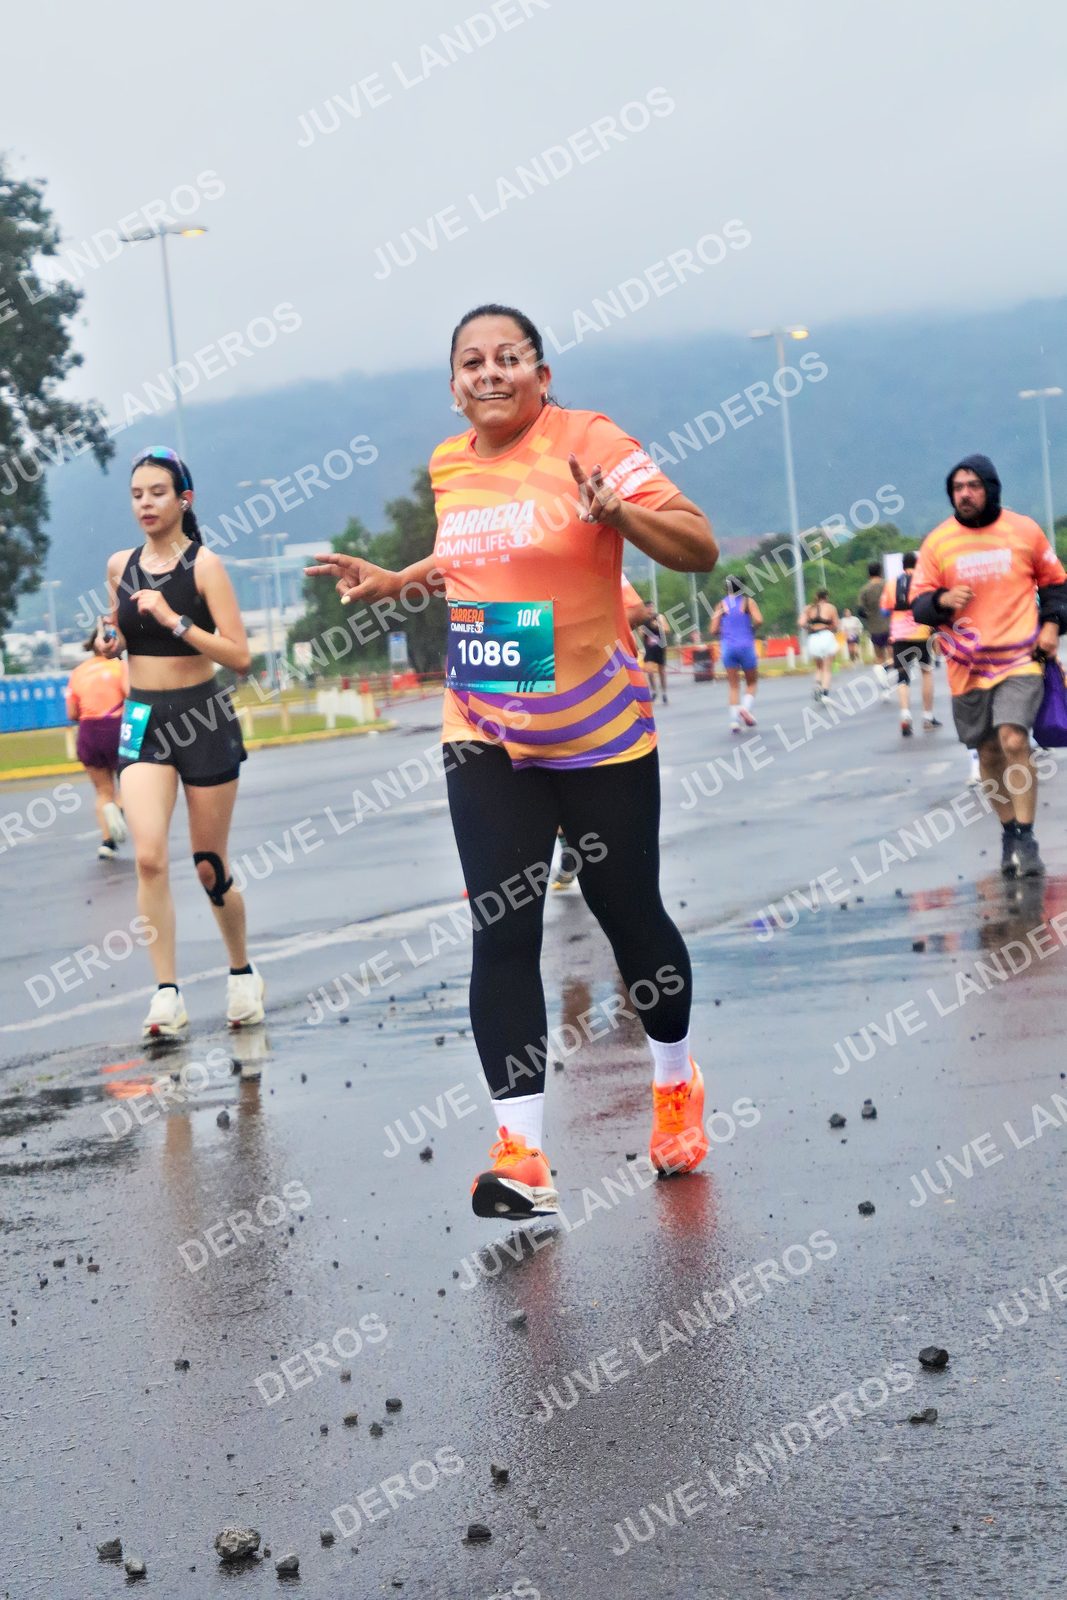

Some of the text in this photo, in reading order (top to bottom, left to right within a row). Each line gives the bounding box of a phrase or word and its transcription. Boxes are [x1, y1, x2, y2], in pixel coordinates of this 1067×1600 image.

[440, 499, 535, 538] CARRERA
[450, 607, 485, 623] CARRERA
[517, 608, 542, 627] 10K
[457, 639, 521, 667] 1086
